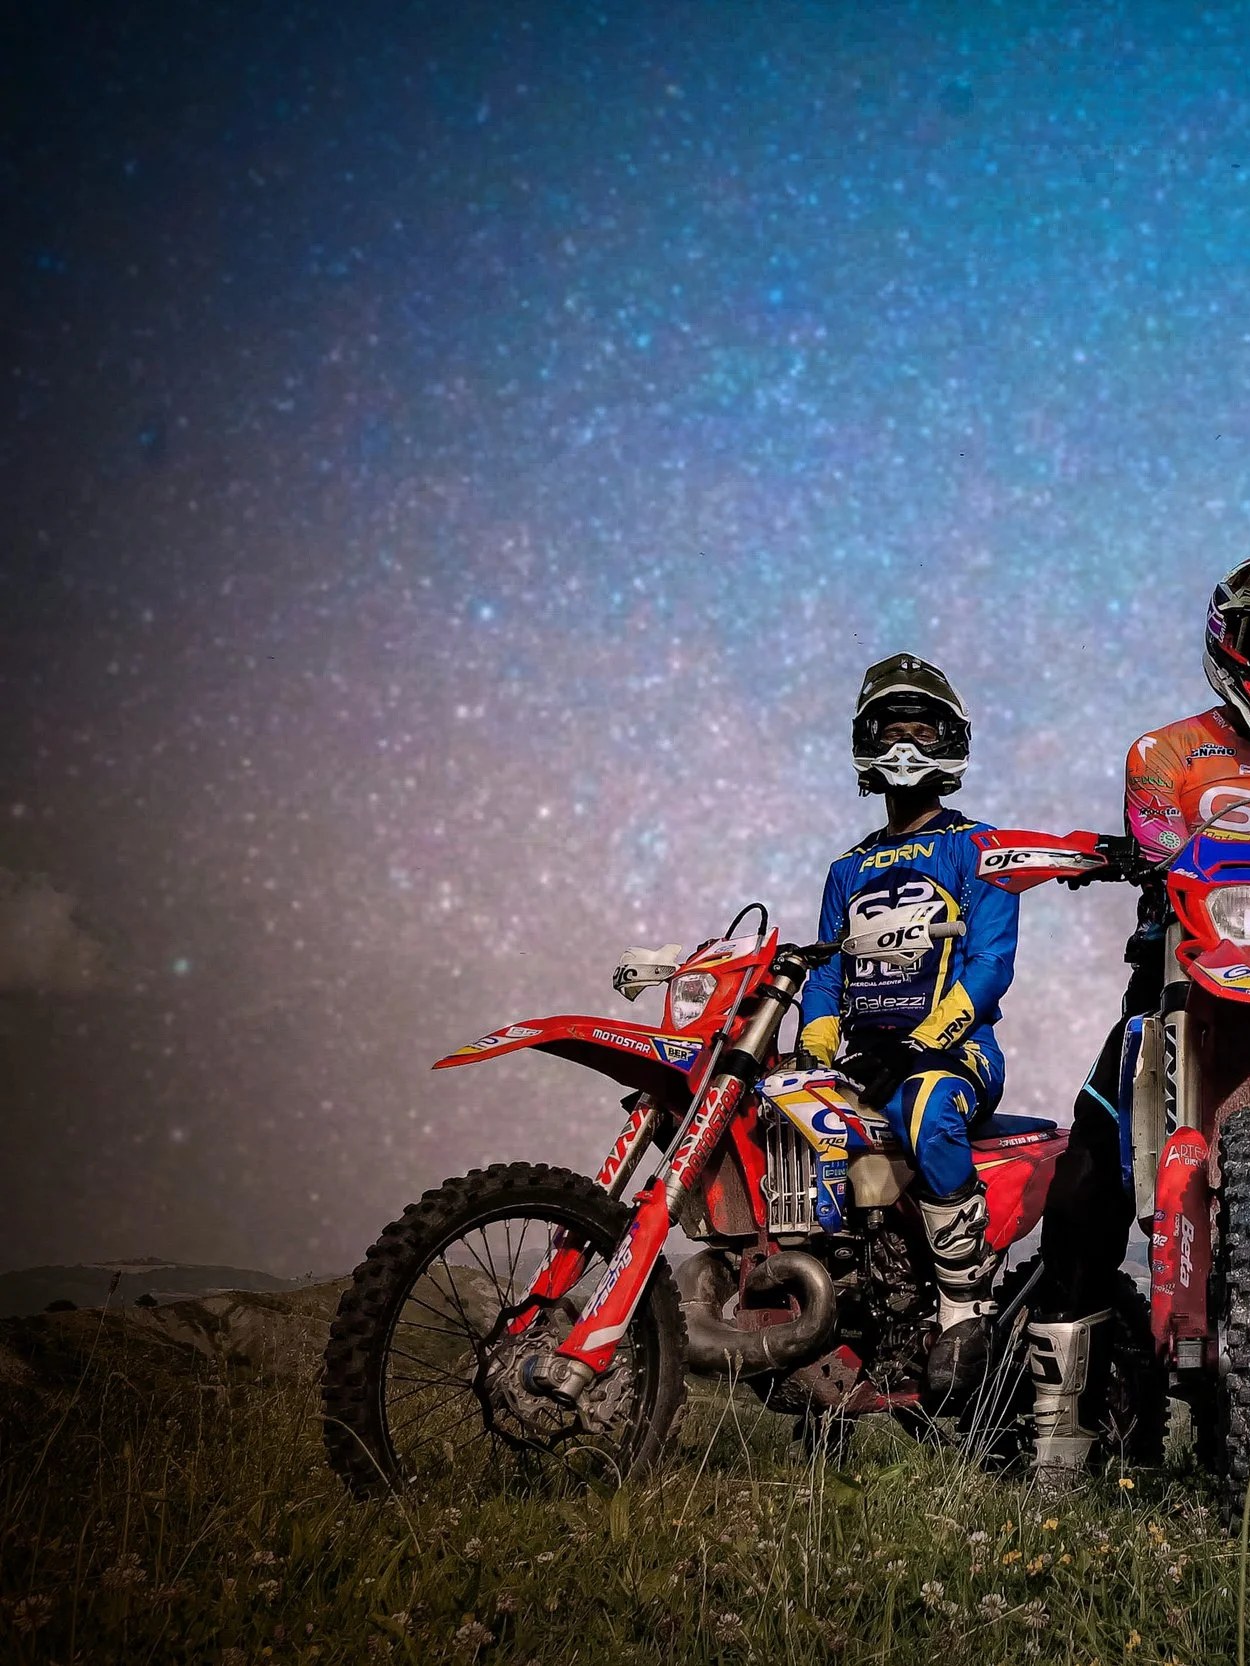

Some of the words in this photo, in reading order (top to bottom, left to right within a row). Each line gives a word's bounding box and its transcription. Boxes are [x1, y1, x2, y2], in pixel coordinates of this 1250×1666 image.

[859, 842, 935, 873] FORN
[984, 850, 1030, 869] ojc
[877, 925, 925, 948] ojc
[855, 992, 926, 1011] Galezzi
[592, 1028, 651, 1054] MOTOSTAR
[668, 1047, 688, 1060] BER
[679, 1078, 741, 1189] MOTOSTAR
[1180, 1215, 1194, 1288] Beta
